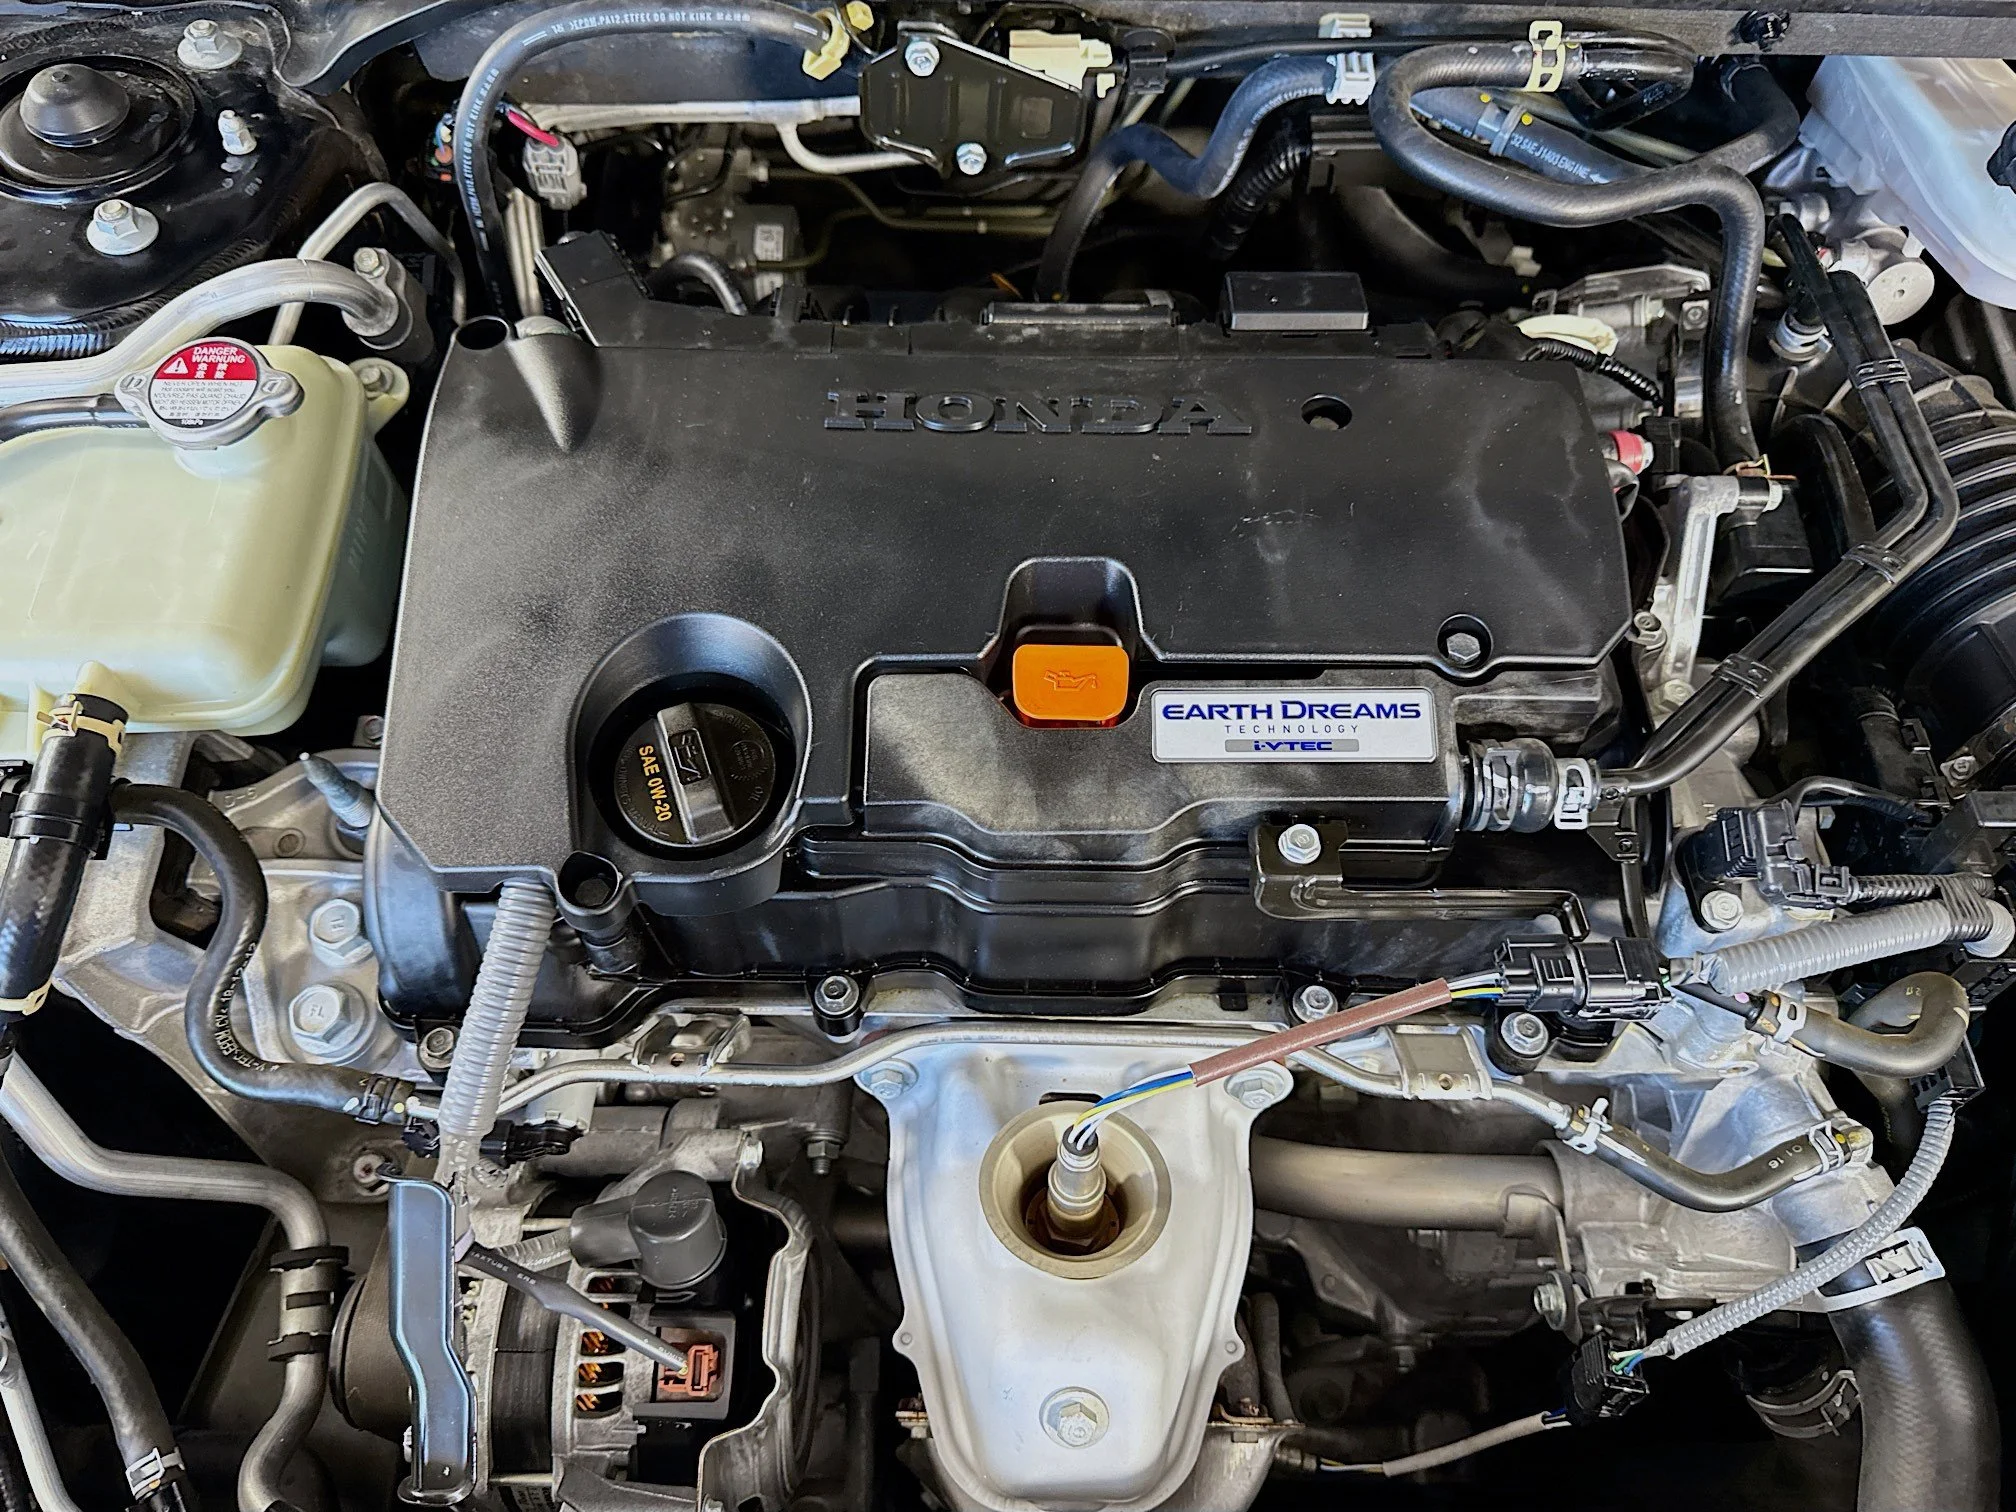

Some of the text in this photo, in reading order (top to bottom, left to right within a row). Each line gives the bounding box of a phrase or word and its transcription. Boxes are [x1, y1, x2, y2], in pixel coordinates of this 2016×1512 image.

[668, 11, 687, 22] NOT
[689, 11, 712, 22] KINK
[193, 346, 238, 355] DANGER
[191, 354, 246, 364] WARNUNG
[824, 391, 1252, 434] HONDA
[1162, 700, 1421, 721] EARTH DREAMS
[1224, 724, 1359, 734] TECHNOLOGY
[1253, 740, 1333, 751] i-VTEC
[638, 745, 673, 822] SAE 0W-20
